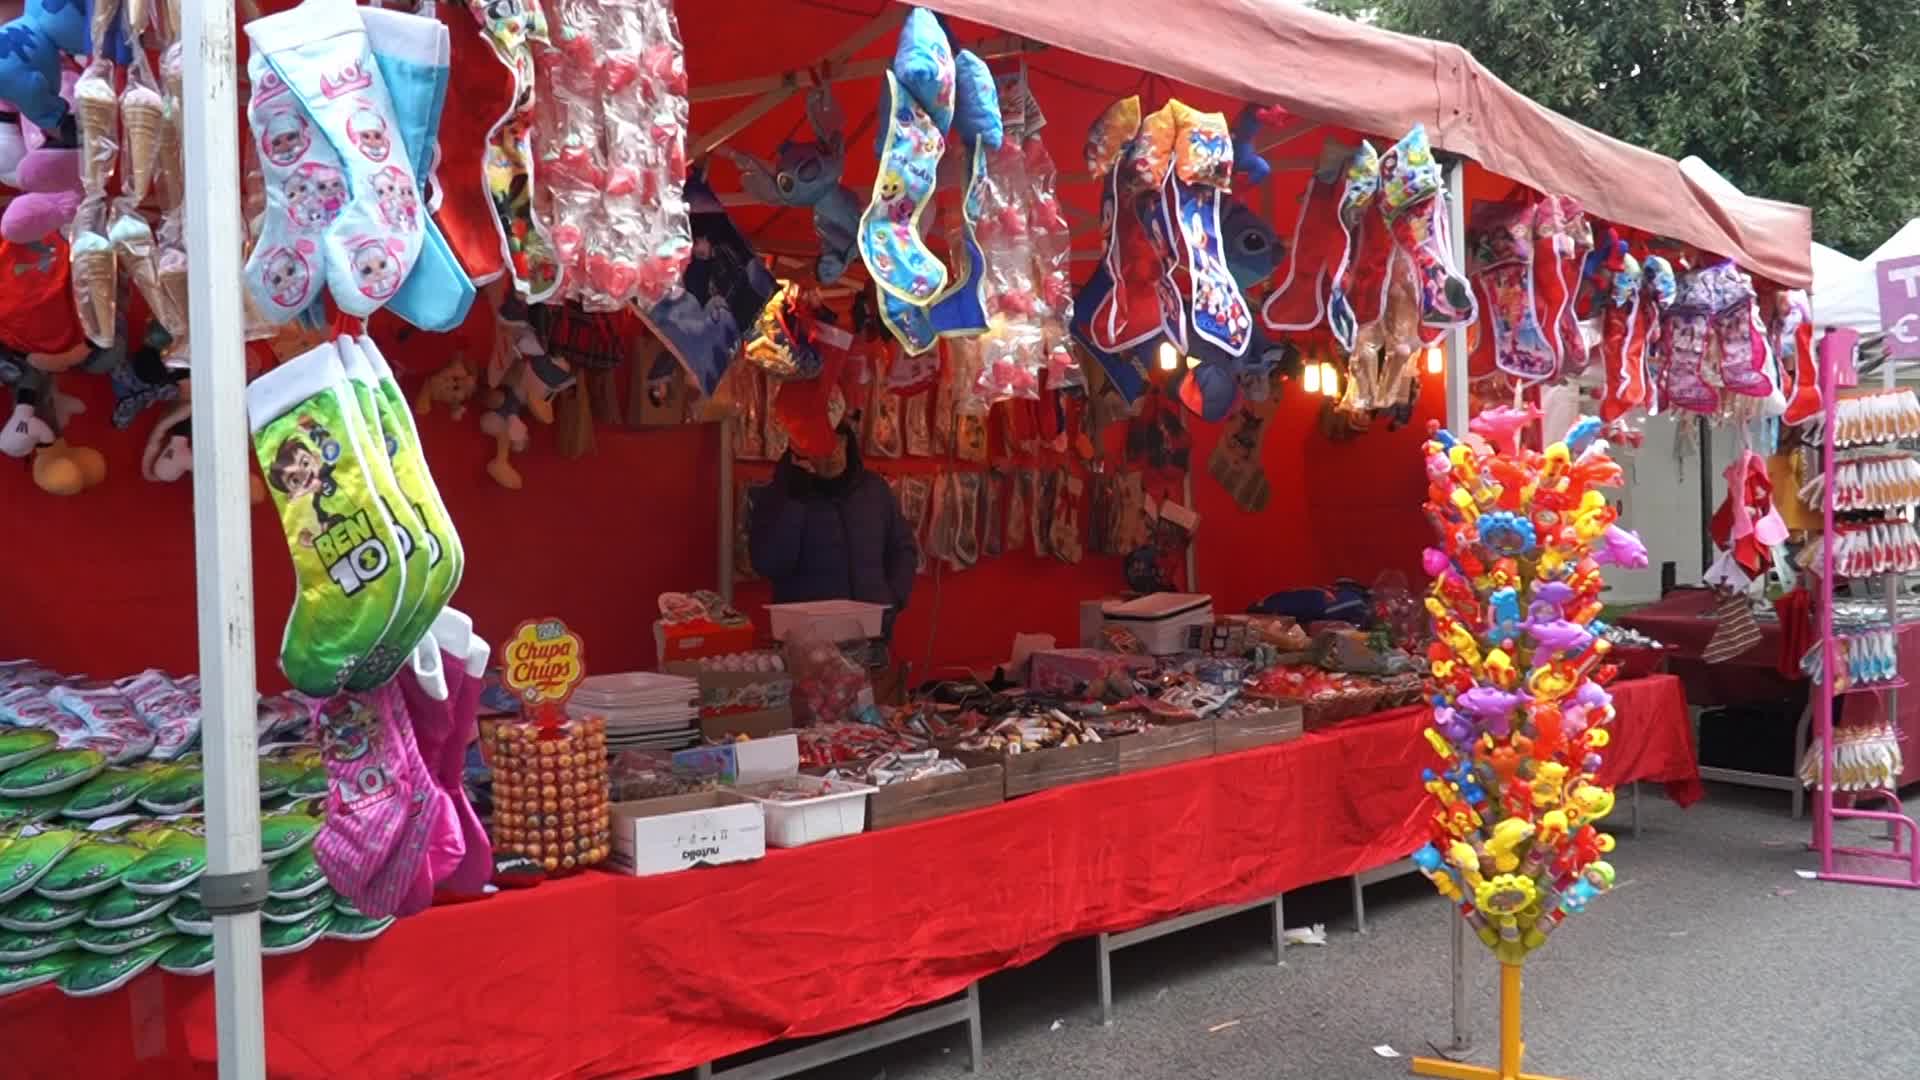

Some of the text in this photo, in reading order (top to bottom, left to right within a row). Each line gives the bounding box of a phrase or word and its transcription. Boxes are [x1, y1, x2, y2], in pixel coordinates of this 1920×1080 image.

[313, 508, 376, 571] BEN
[328, 537, 390, 597] 10
[515, 641, 571, 663] Chupa
[514, 660, 570, 686] Chups
[682, 847, 720, 860] nutella
